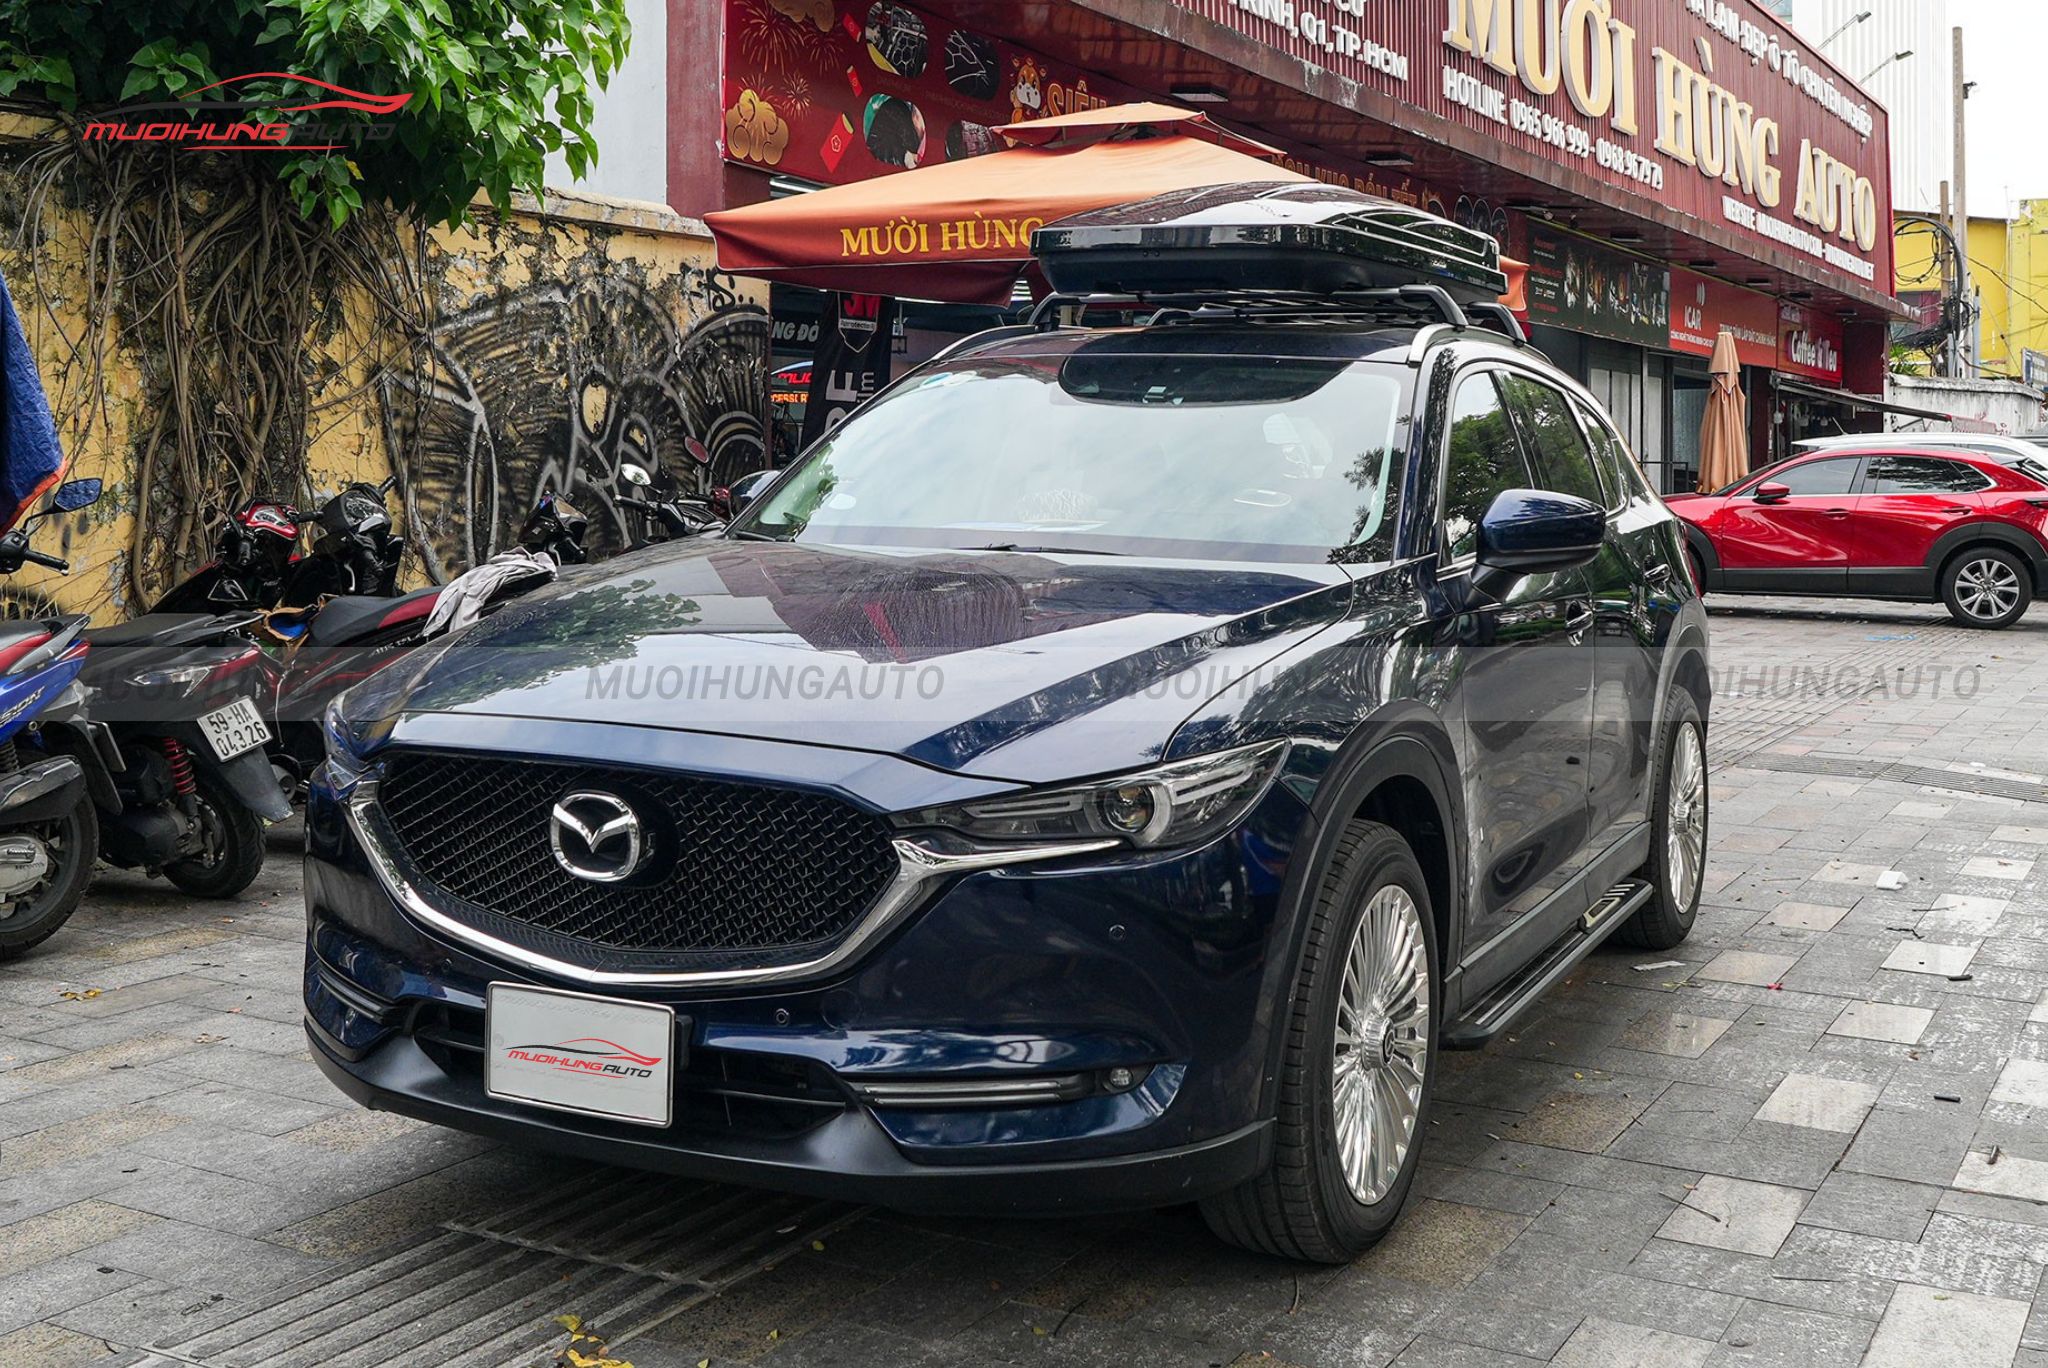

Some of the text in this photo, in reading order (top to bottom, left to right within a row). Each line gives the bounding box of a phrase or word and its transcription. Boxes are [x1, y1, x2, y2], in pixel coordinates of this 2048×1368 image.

[1332, 25, 1408, 81] TP.HCM
[1768, 34, 1782, 72] Ô
[1510, 98, 1542, 139] 0965
[1542, 113, 1566, 149] 966
[1565, 124, 1591, 158] 999
[1596, 137, 1625, 174] 0968
[1652, 36, 1781, 207] HÙNG
[1793, 138, 1877, 252] AUTO
[840, 215, 930, 256] MƯỜI
[1684, 306, 1703, 331] ICAR
[1791, 330, 1816, 367] Coffee
[206, 702, 254, 734] 59-HA
